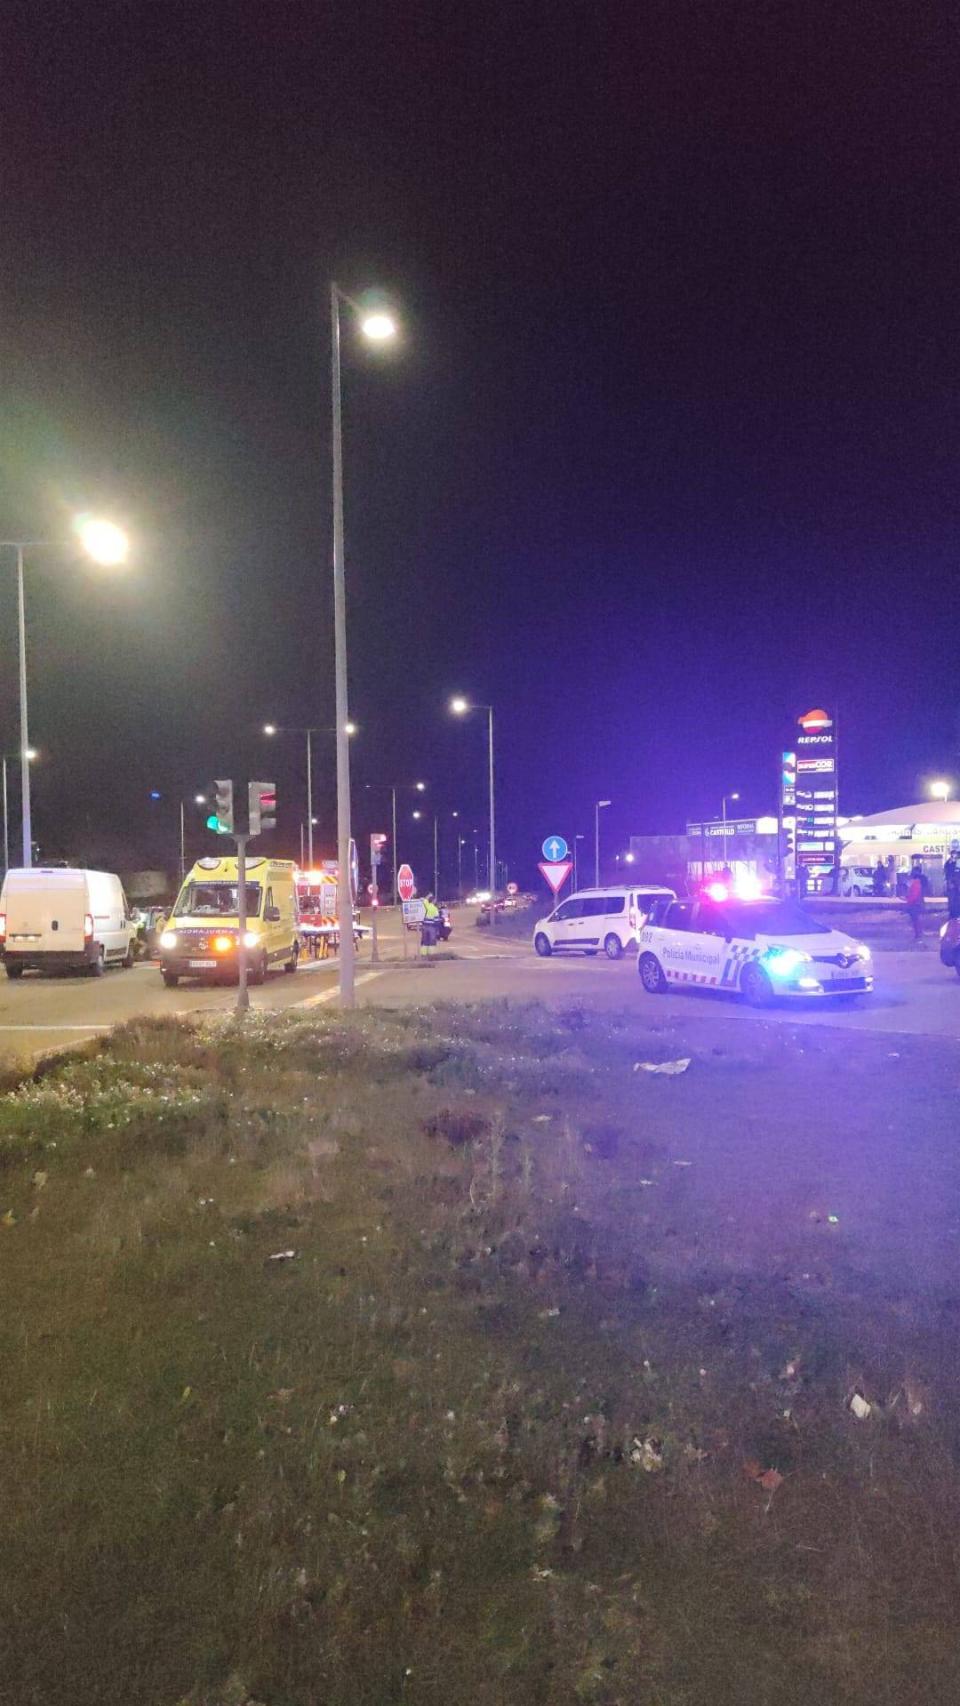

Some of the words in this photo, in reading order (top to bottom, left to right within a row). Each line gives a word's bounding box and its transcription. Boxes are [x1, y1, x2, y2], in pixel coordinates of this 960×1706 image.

[797, 735, 833, 744] REPSOL
[399, 879, 413, 888] STOP
[685, 950, 720, 965] Municipal
